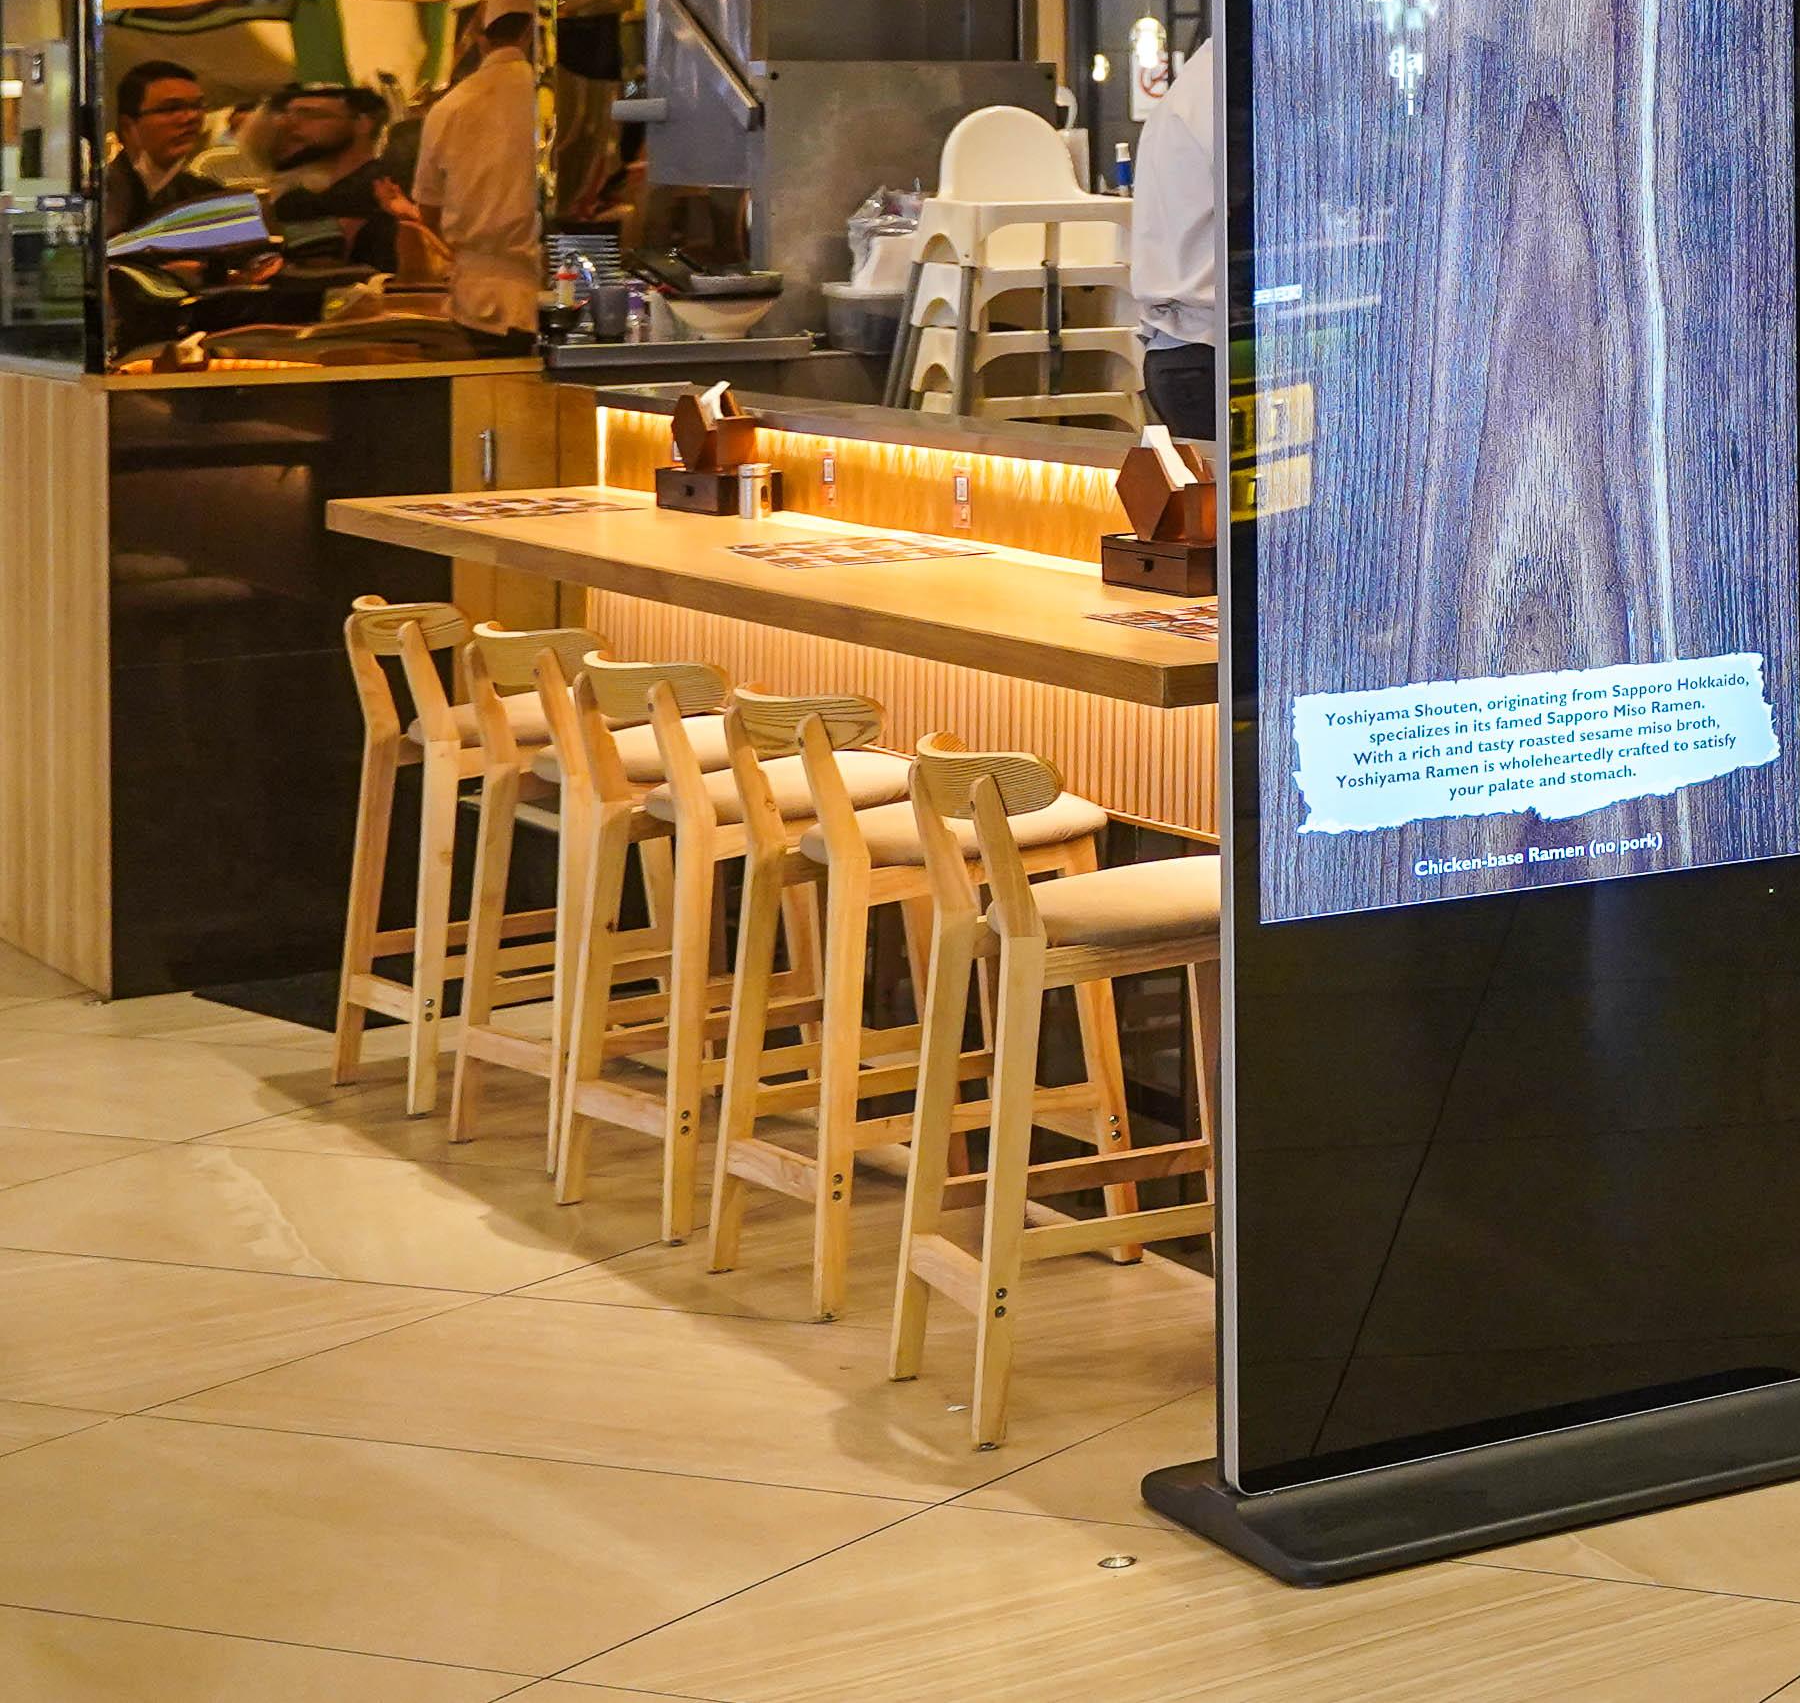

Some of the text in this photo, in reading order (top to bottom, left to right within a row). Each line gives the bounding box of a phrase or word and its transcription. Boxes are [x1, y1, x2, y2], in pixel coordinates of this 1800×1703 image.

[1325, 673, 1749, 726] Yoshiyama Shouten, originating from Sapporo Hokkaido,
[1369, 699, 1705, 745] specializes in its famed Sapporo Miso Ramen.
[1336, 733, 1736, 788] Yoshiyama Ramen is wholeheartedly crafted to satisfy
[1353, 716, 1720, 765] With a rich and tasty roasted sesame miso broth,
[1449, 765, 1637, 801] your palate and stomach.
[1414, 831, 1663, 876] Chicken-base Ramen (no pork)
